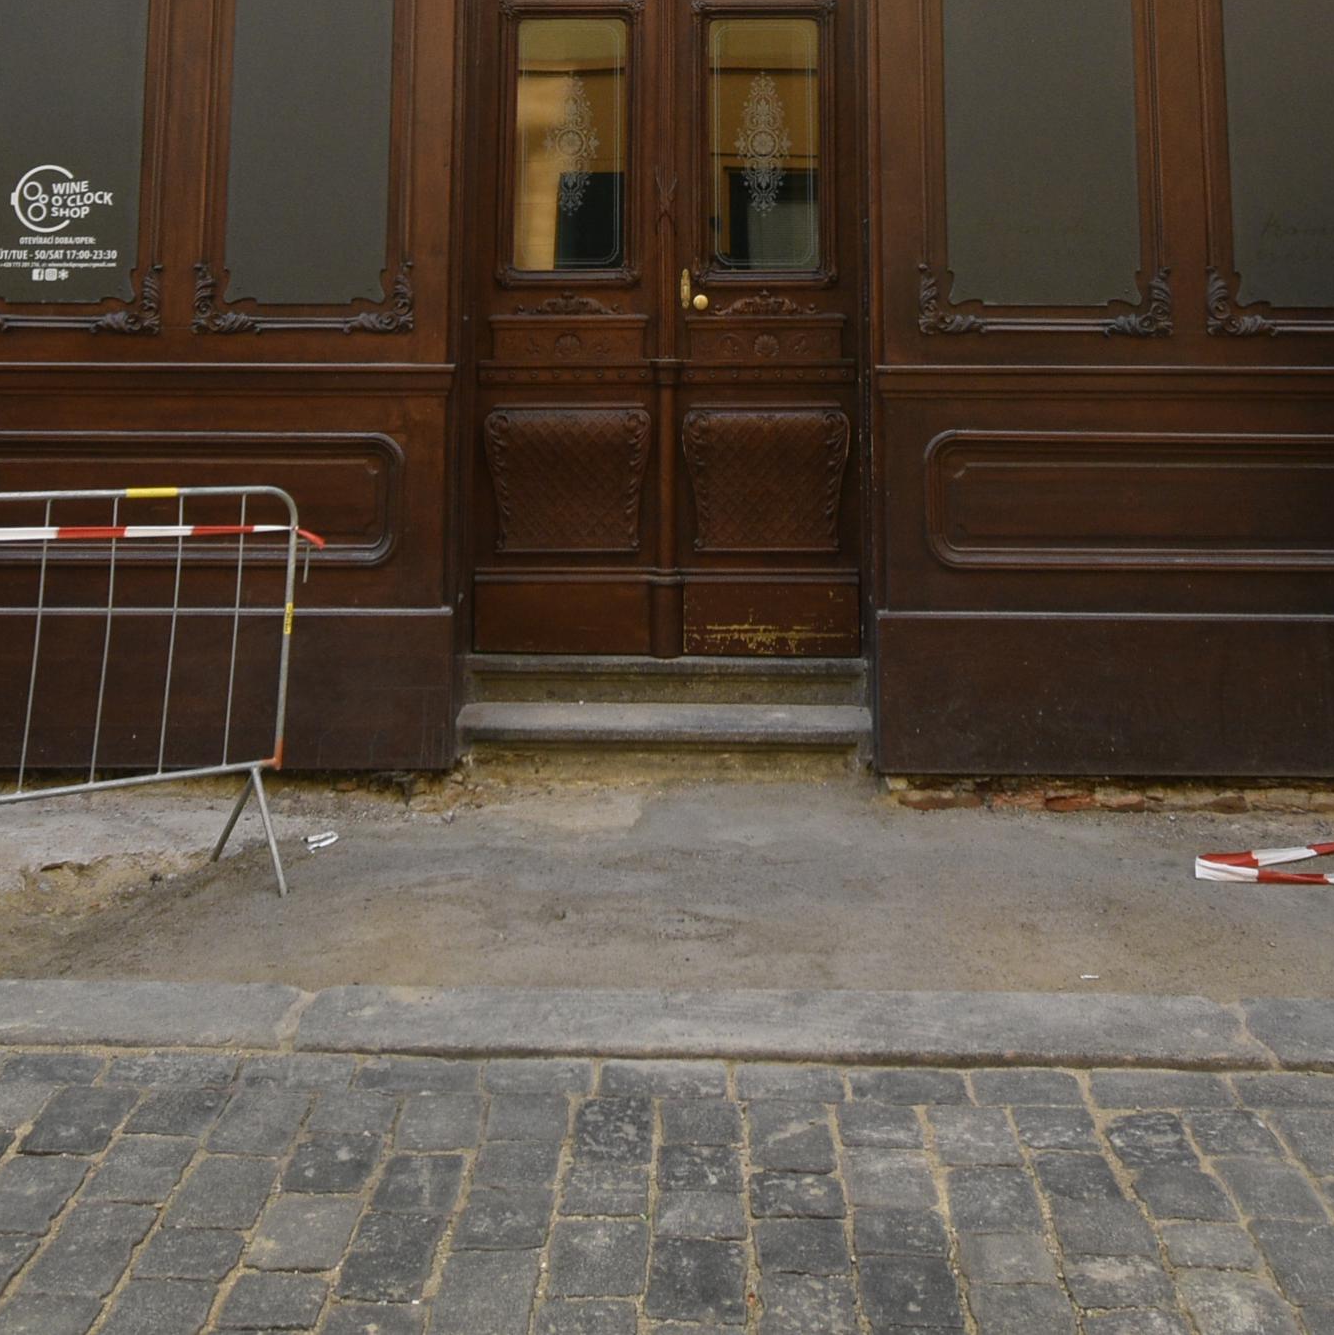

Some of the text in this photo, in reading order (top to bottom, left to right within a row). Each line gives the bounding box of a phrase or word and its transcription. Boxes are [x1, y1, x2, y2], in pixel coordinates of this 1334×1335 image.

[51, 180, 89, 195] WINE
[50, 206, 90, 219] SHOP
[34, 249, 64, 260] SO/SAT
[66, 249, 118, 260] 17:00-23:30
